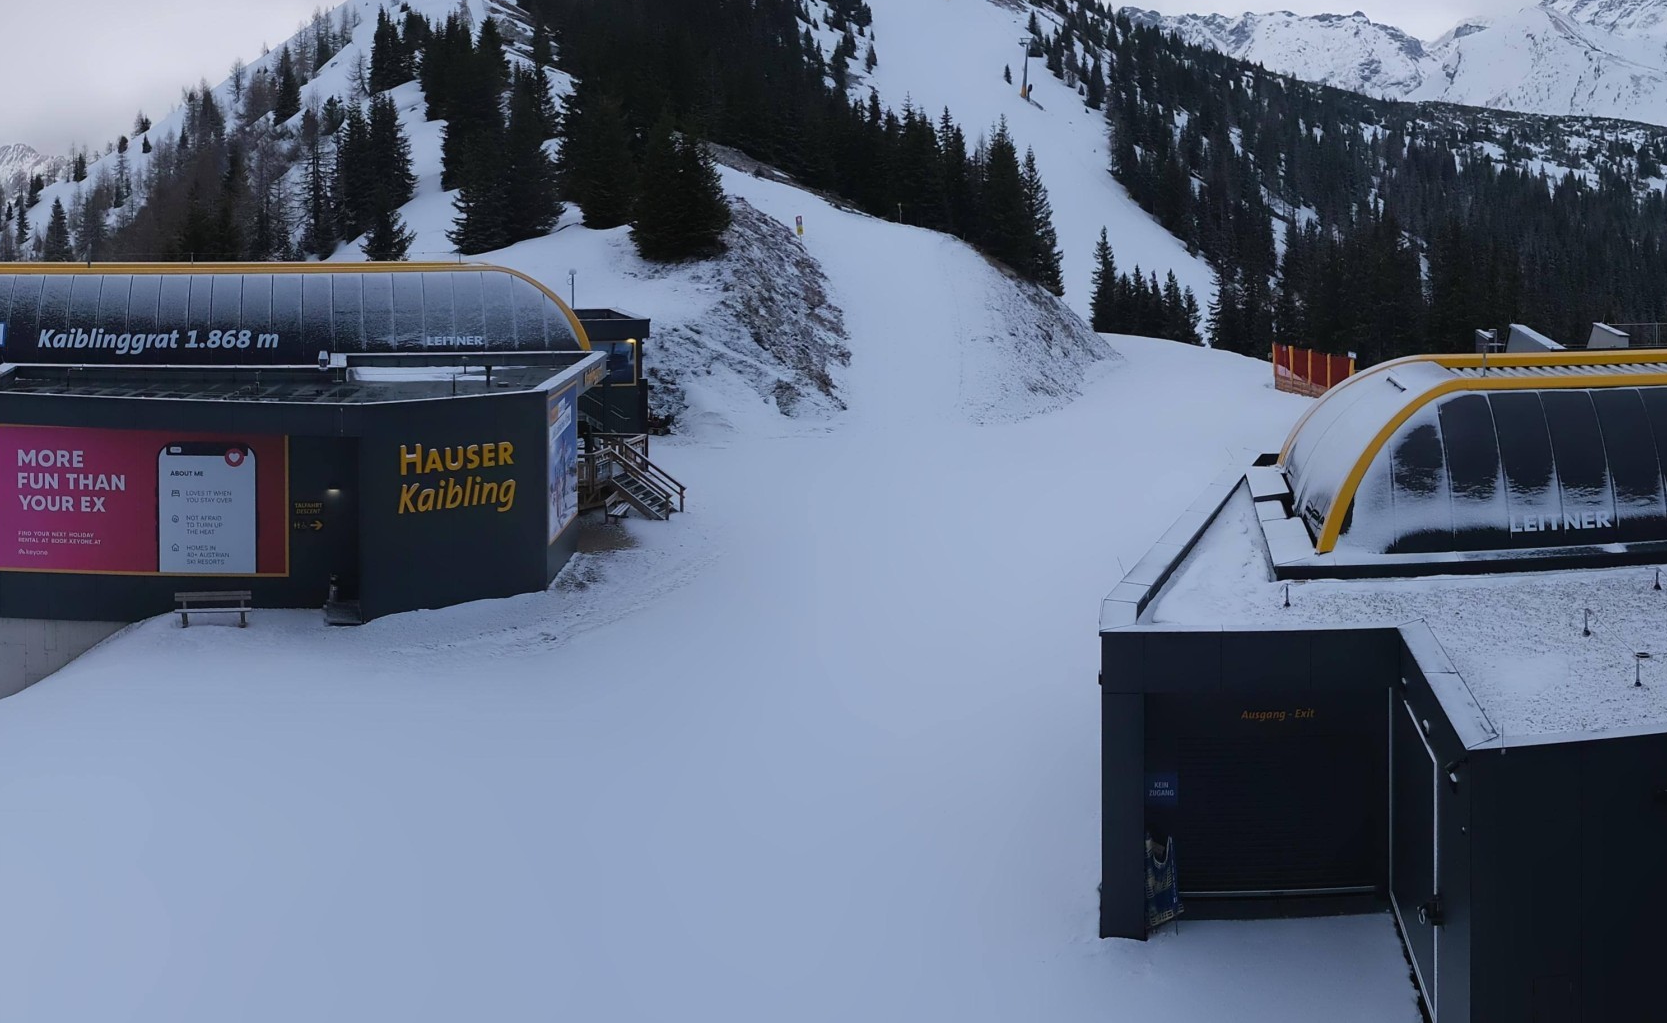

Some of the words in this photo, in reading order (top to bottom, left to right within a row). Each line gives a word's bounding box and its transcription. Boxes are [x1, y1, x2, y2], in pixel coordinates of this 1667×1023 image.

[37, 329, 178, 354] Kaiblinggrat
[185, 329, 251, 349] 1.868
[257, 333, 279, 348] m
[426, 336, 483, 346] LEITNER
[17, 449, 84, 467] MORE
[400, 441, 514, 476] HAUSER
[17, 472, 59, 489] FUN
[66, 473, 125, 491] THAN
[19, 495, 74, 512] YOUR
[81, 496, 106, 512] EX
[398, 476, 516, 514] Kaibling
[1510, 510, 1612, 533] LEITNER
[1241, 710, 1285, 721] Ausgang
[1295, 708, 1315, 719] Exit
[1149, 789, 1174, 797] ZUGANG
[1154, 781, 1169, 789] KEIN
